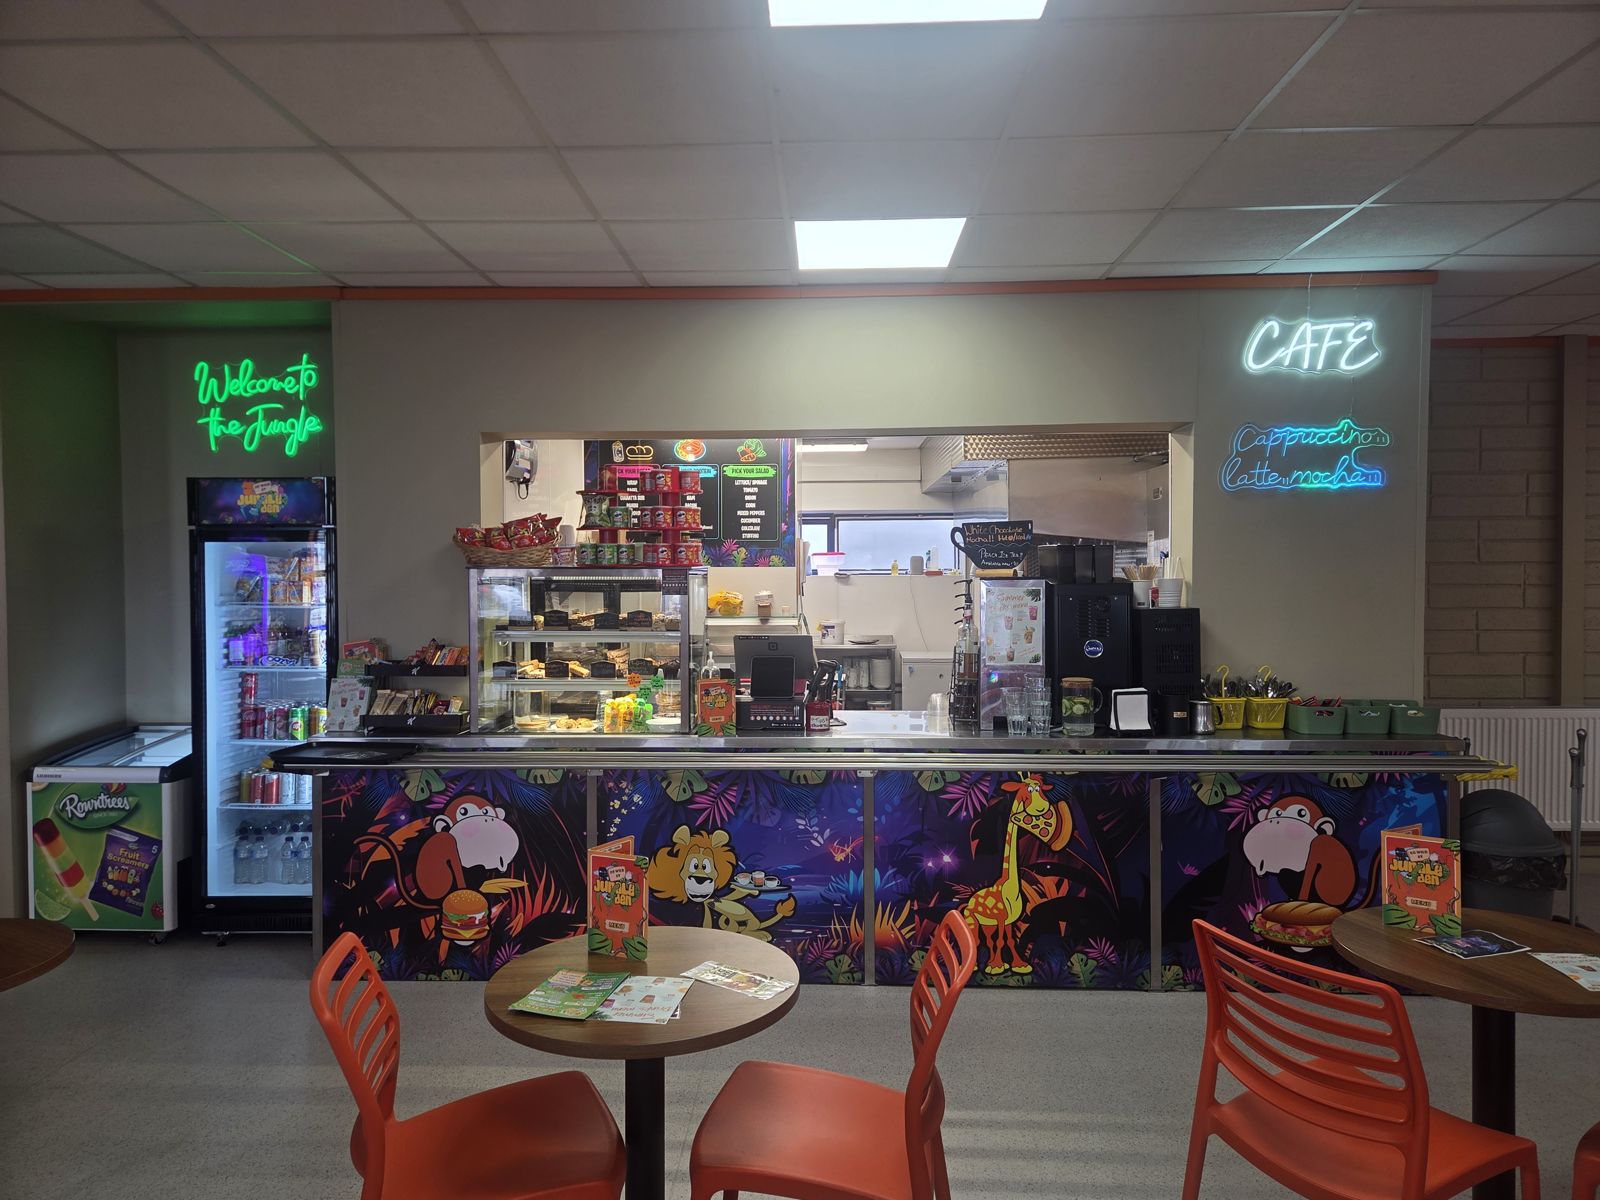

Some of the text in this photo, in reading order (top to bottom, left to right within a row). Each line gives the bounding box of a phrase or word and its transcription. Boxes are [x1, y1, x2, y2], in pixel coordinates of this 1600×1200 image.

[1246, 319, 1380, 371] CAFE
[193, 352, 318, 404] Welcome to
[196, 403, 323, 457] the Jungle
[119, 847, 140, 860] Fruit
[151, 845, 159, 854] 5
[1417, 873, 1440, 885] den
[614, 893, 632, 906] den
[608, 921, 626, 930] MENU
